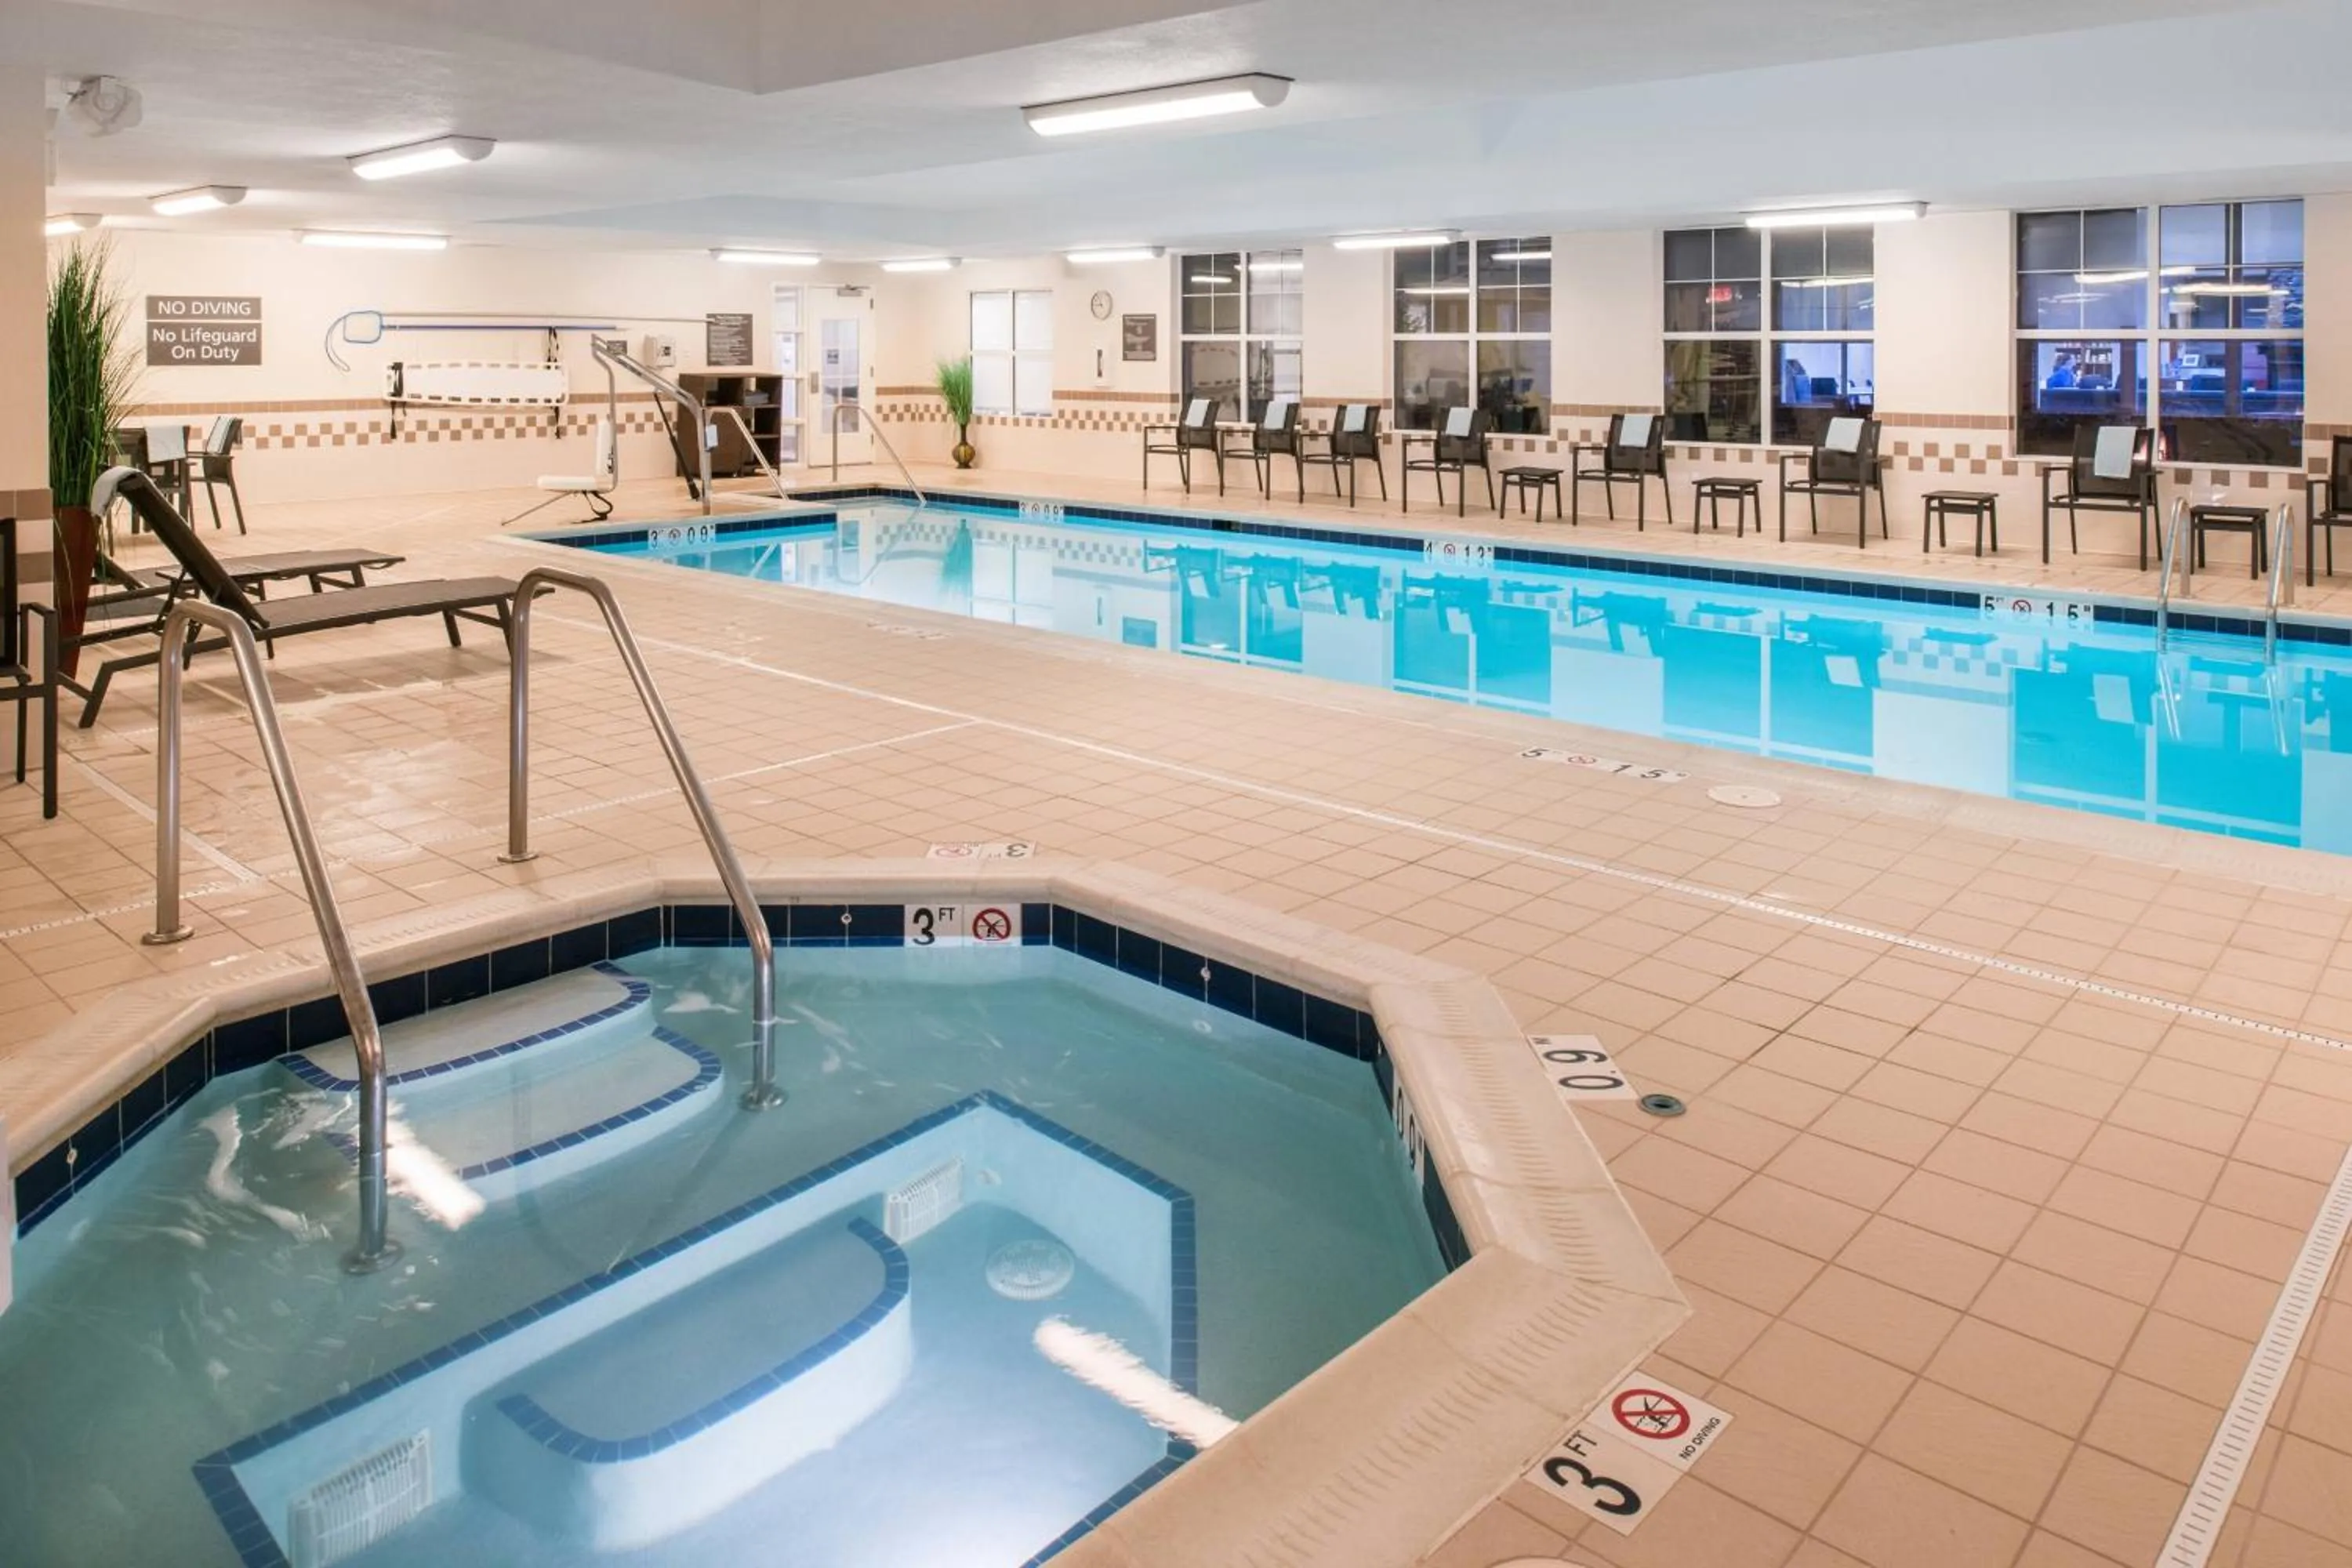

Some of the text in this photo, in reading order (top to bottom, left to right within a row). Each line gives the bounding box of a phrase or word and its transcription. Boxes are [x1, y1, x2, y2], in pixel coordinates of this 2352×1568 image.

[158, 301, 251, 315] NO DIVING
[153, 328, 257, 345] No Lifeguard
[171, 346, 239, 361] On Duty
[913, 907, 956, 946] 3 FT
[1679, 1417, 1721, 1461] NO DIVING
[1542, 1429, 1642, 1515] 3 FT
